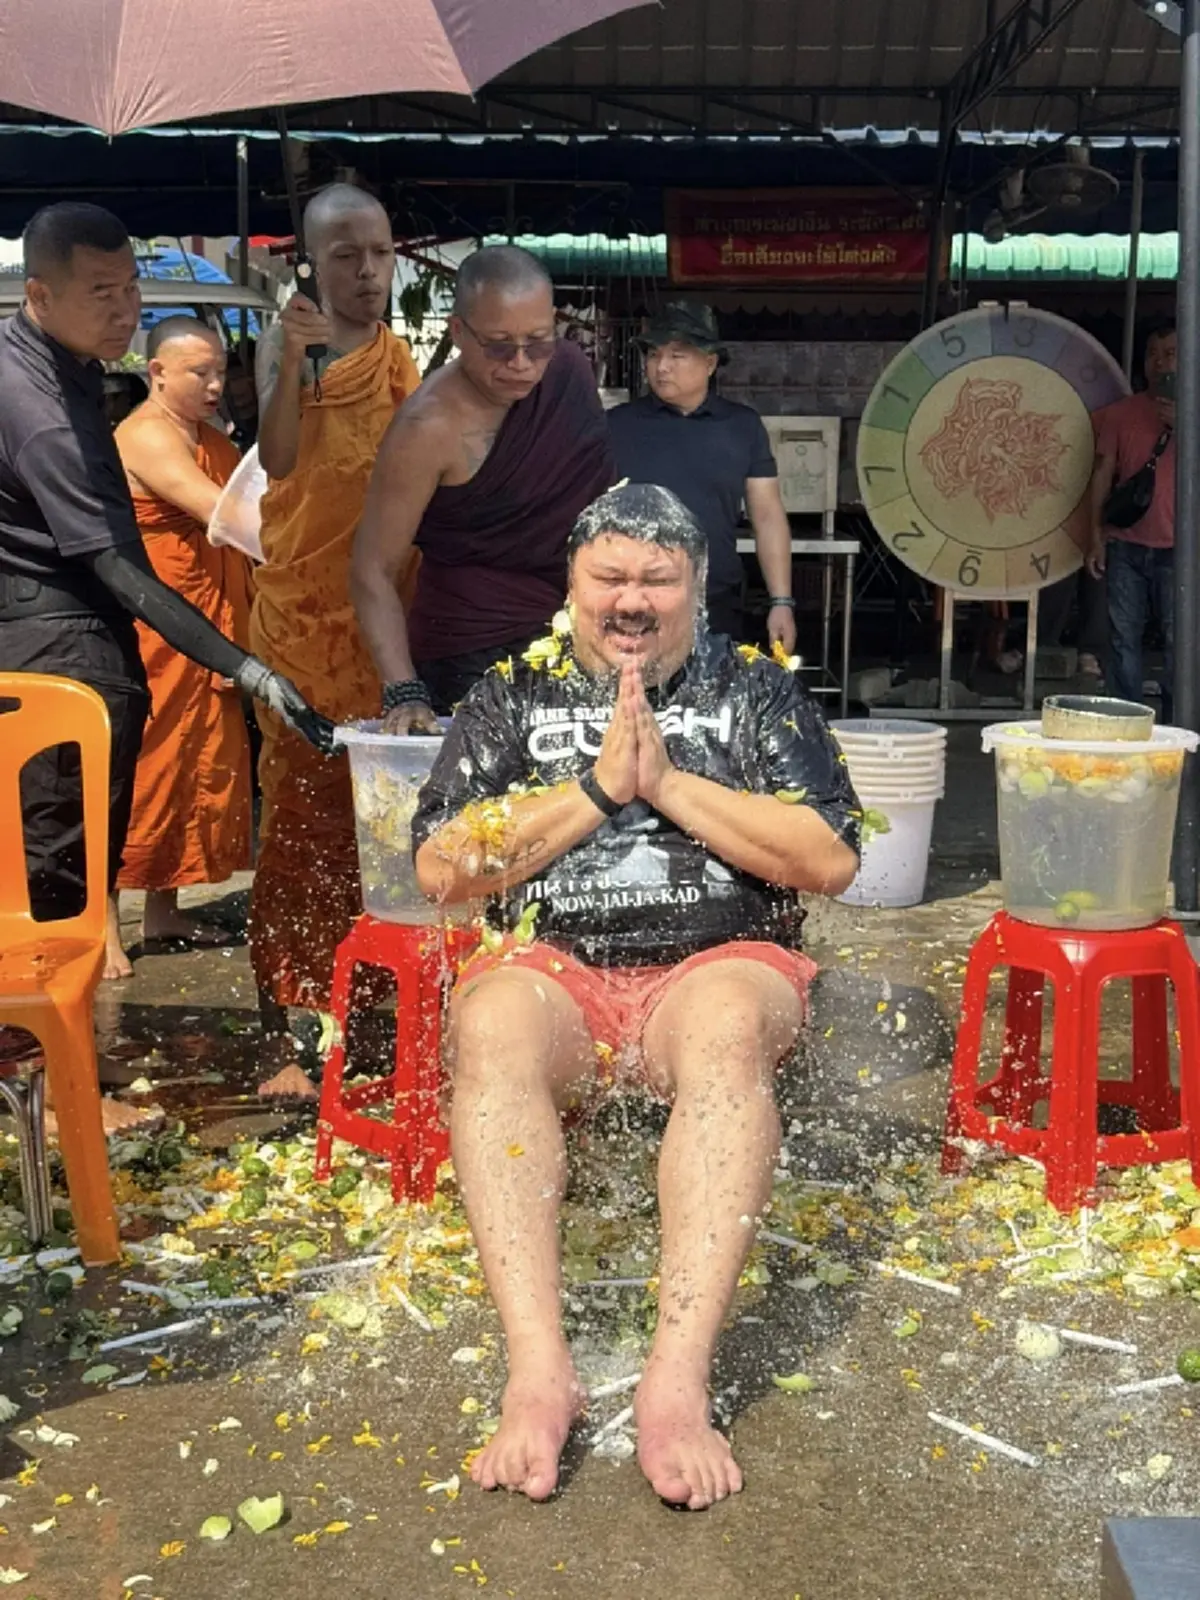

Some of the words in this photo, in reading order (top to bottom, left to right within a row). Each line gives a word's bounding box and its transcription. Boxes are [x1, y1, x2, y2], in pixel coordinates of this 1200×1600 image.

[939, 324, 966, 358] 5
[1013, 316, 1038, 348] 3
[882, 383, 911, 404] 1
[863, 465, 896, 486] 7
[892, 521, 926, 551] 2
[1029, 552, 1051, 580] 4
